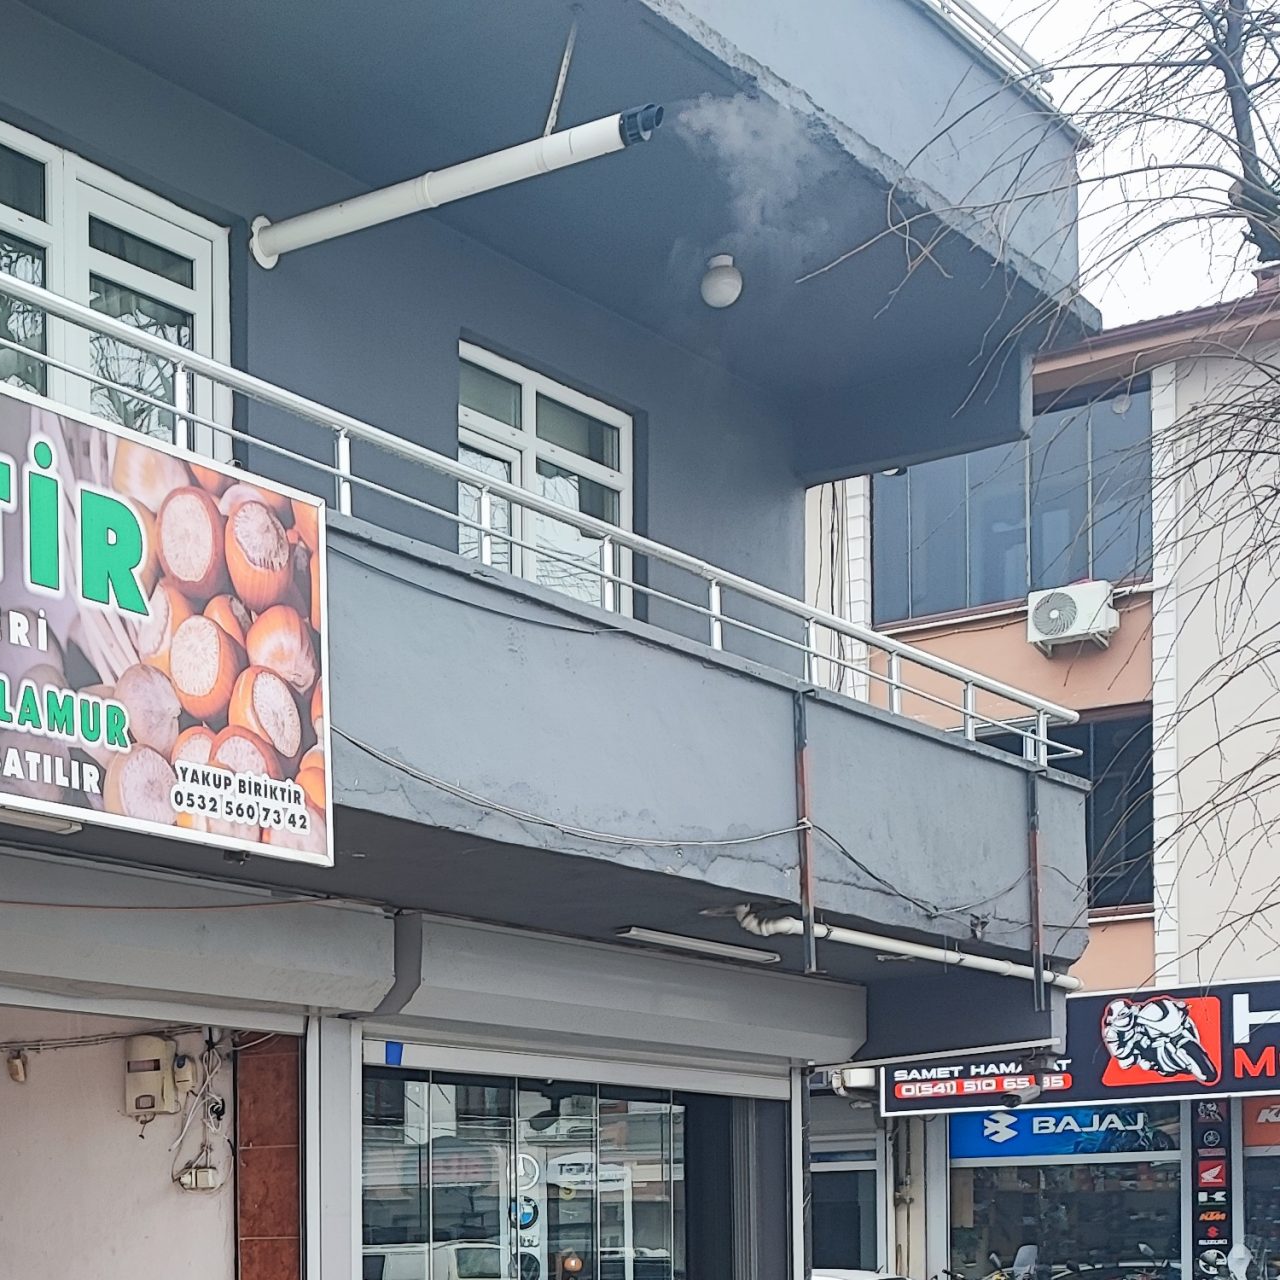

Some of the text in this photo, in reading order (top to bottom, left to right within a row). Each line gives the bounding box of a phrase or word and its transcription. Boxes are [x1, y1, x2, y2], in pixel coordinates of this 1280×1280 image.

[179, 766, 302, 806] YAKUP BİRİKTİR
[174, 790, 307, 830] 0532 560 73 42
[893, 1065, 963, 1082] SAMET
[963, 1079, 996, 1093] 510
[1033, 1112, 1146, 1135] BAJAJ
